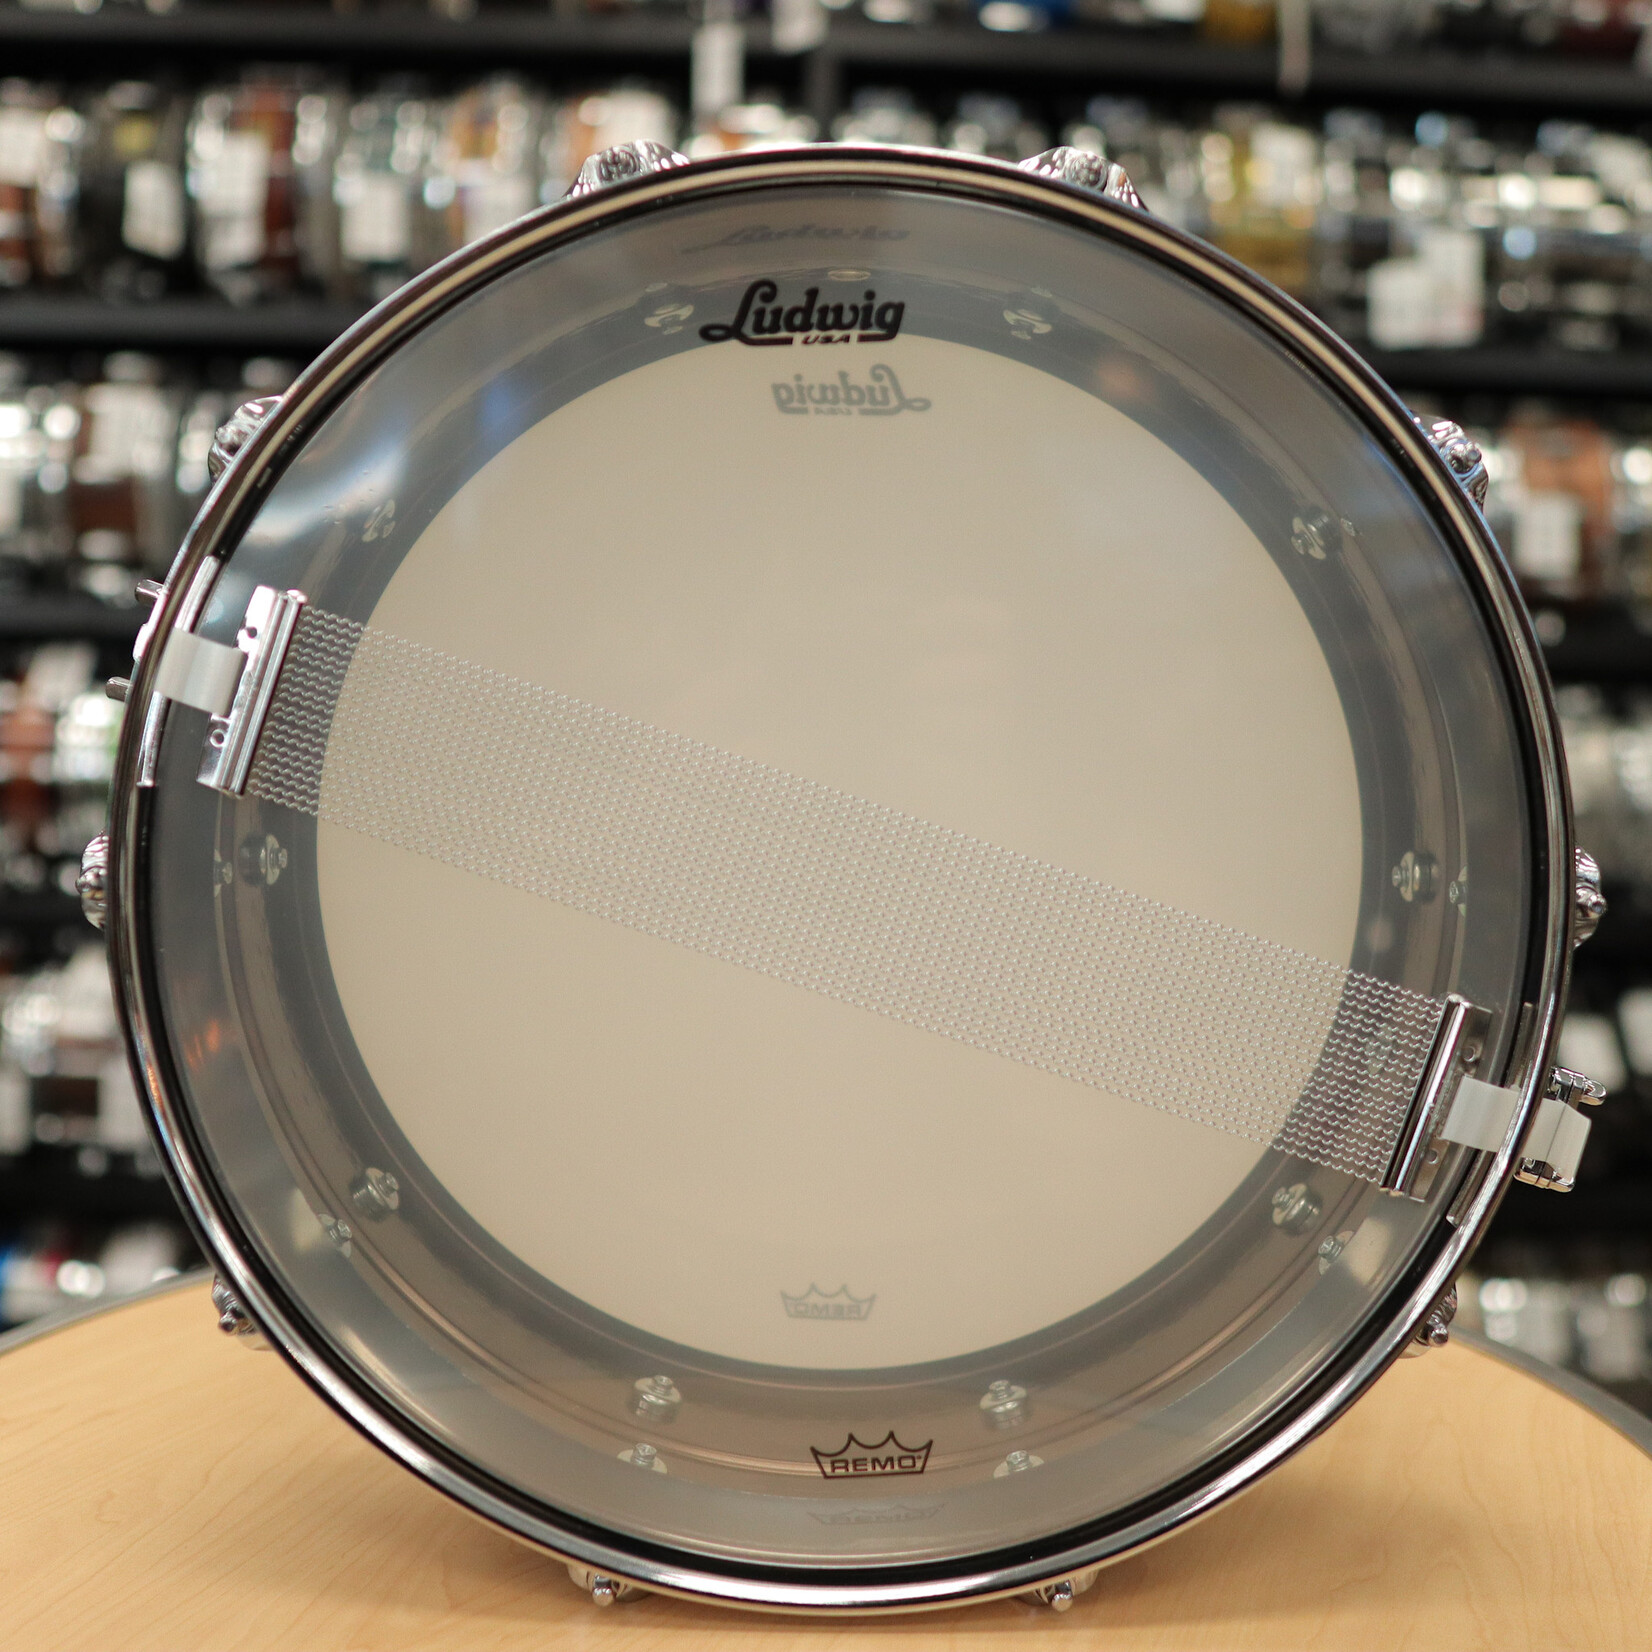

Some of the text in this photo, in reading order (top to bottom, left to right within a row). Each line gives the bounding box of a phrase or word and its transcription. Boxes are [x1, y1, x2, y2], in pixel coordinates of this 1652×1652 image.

[699, 279, 905, 346] Ludwig
[801, 334, 850, 344] USA
[830, 1455, 917, 1473] REMO
